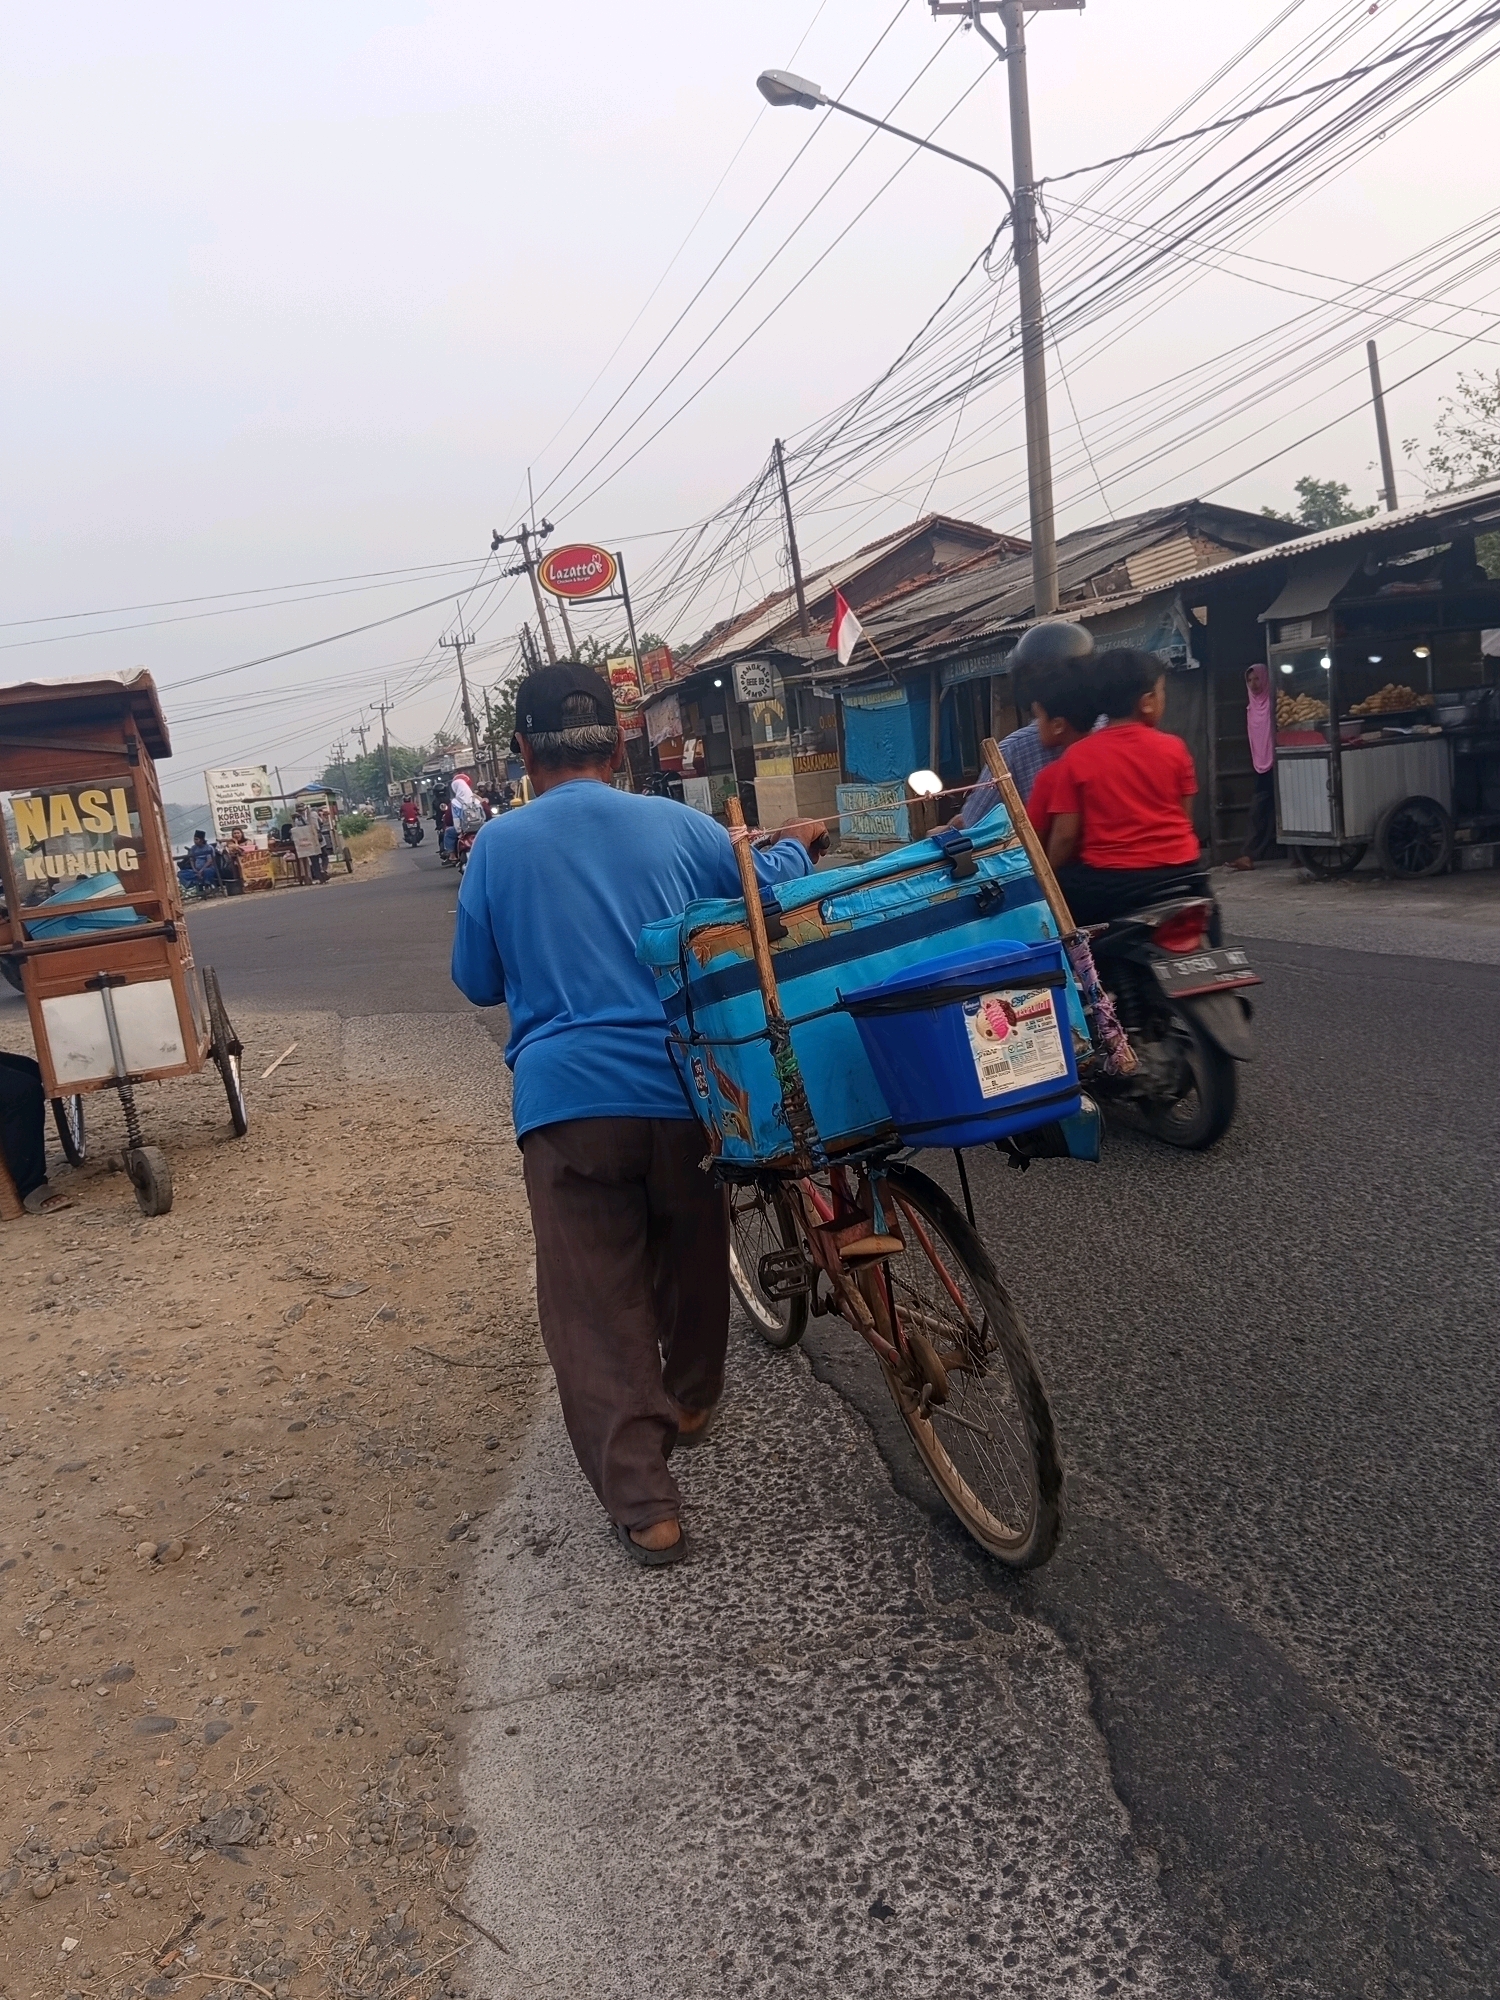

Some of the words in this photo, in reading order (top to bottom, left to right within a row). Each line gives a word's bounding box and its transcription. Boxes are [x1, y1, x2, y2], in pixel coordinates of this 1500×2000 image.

[549, 562, 597, 580] Lazatto
[218, 811, 251, 822] KORBAN
[223, 804, 250, 814] PEDULI
[12, 788, 133, 850] NASI
[24, 848, 139, 881] KUNING
